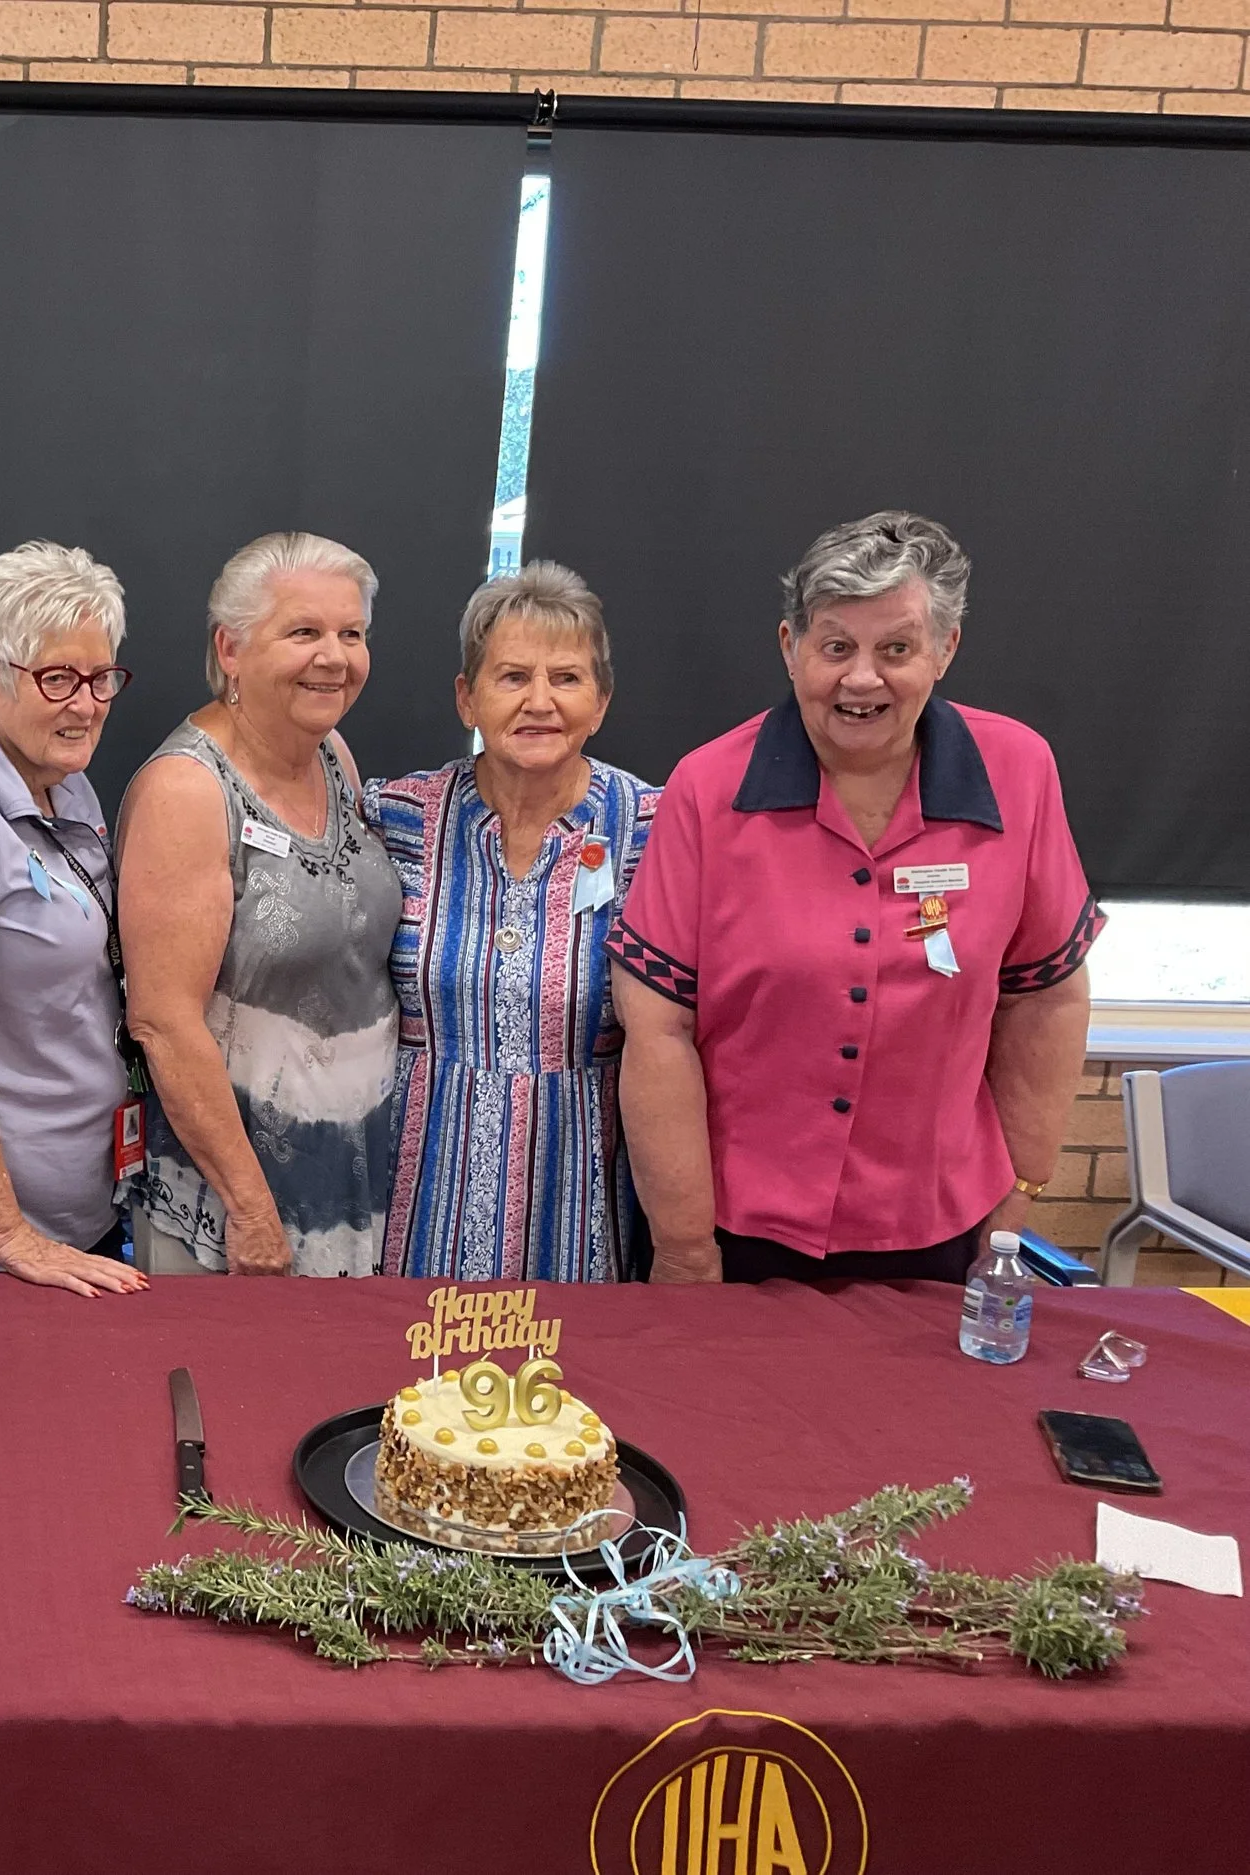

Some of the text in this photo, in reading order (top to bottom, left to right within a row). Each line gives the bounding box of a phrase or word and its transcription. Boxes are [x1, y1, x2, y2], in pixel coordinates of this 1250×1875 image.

[63, 849, 91, 887] Western
[427, 1286, 537, 1328] Happy
[405, 1314, 562, 1360] Birthday
[459, 1358, 564, 1432] 96
